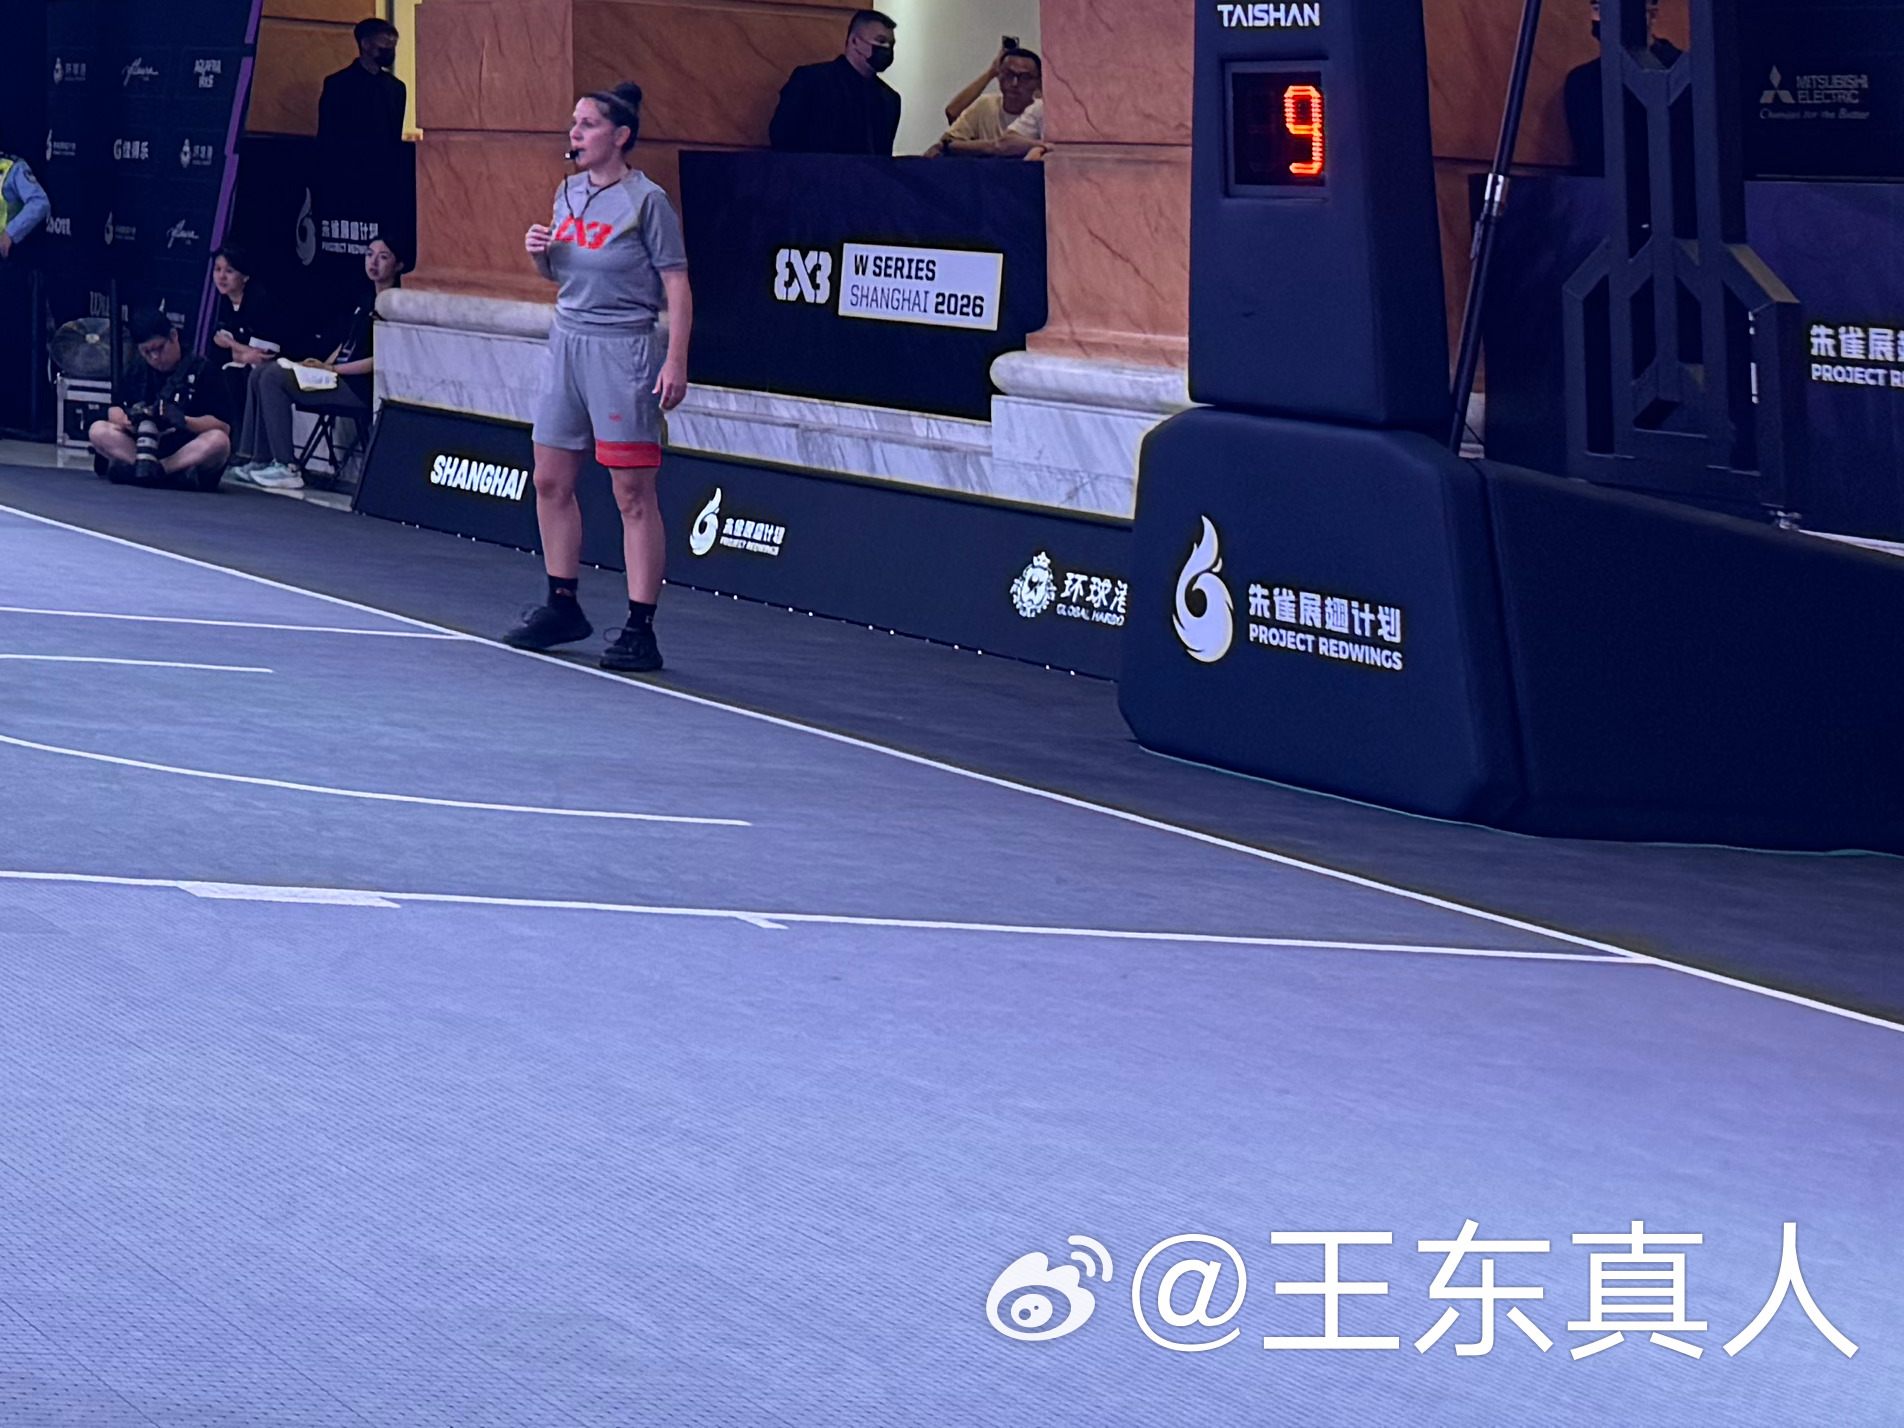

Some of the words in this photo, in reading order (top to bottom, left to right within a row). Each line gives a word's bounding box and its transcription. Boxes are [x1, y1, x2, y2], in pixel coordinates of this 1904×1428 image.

[1217, 3, 1320, 27] TAISHAN
[1796, 74, 1869, 89] MITSUBISHI
[1797, 90, 1859, 104] ELECTRIC
[1284, 85, 1323, 175] 9
[854, 254, 869, 276] W
[873, 256, 936, 281] SERIES
[850, 284, 930, 313] SHANGHAI
[934, 292, 985, 318] 2026
[1811, 363, 1888, 386] PROJECT
[430, 455, 529, 501] SHANGHAI
[1248, 583, 1402, 643] 朱雀展翅计划
[1249, 623, 1315, 653] PROJECT
[1318, 636, 1403, 671] REDWINGS
